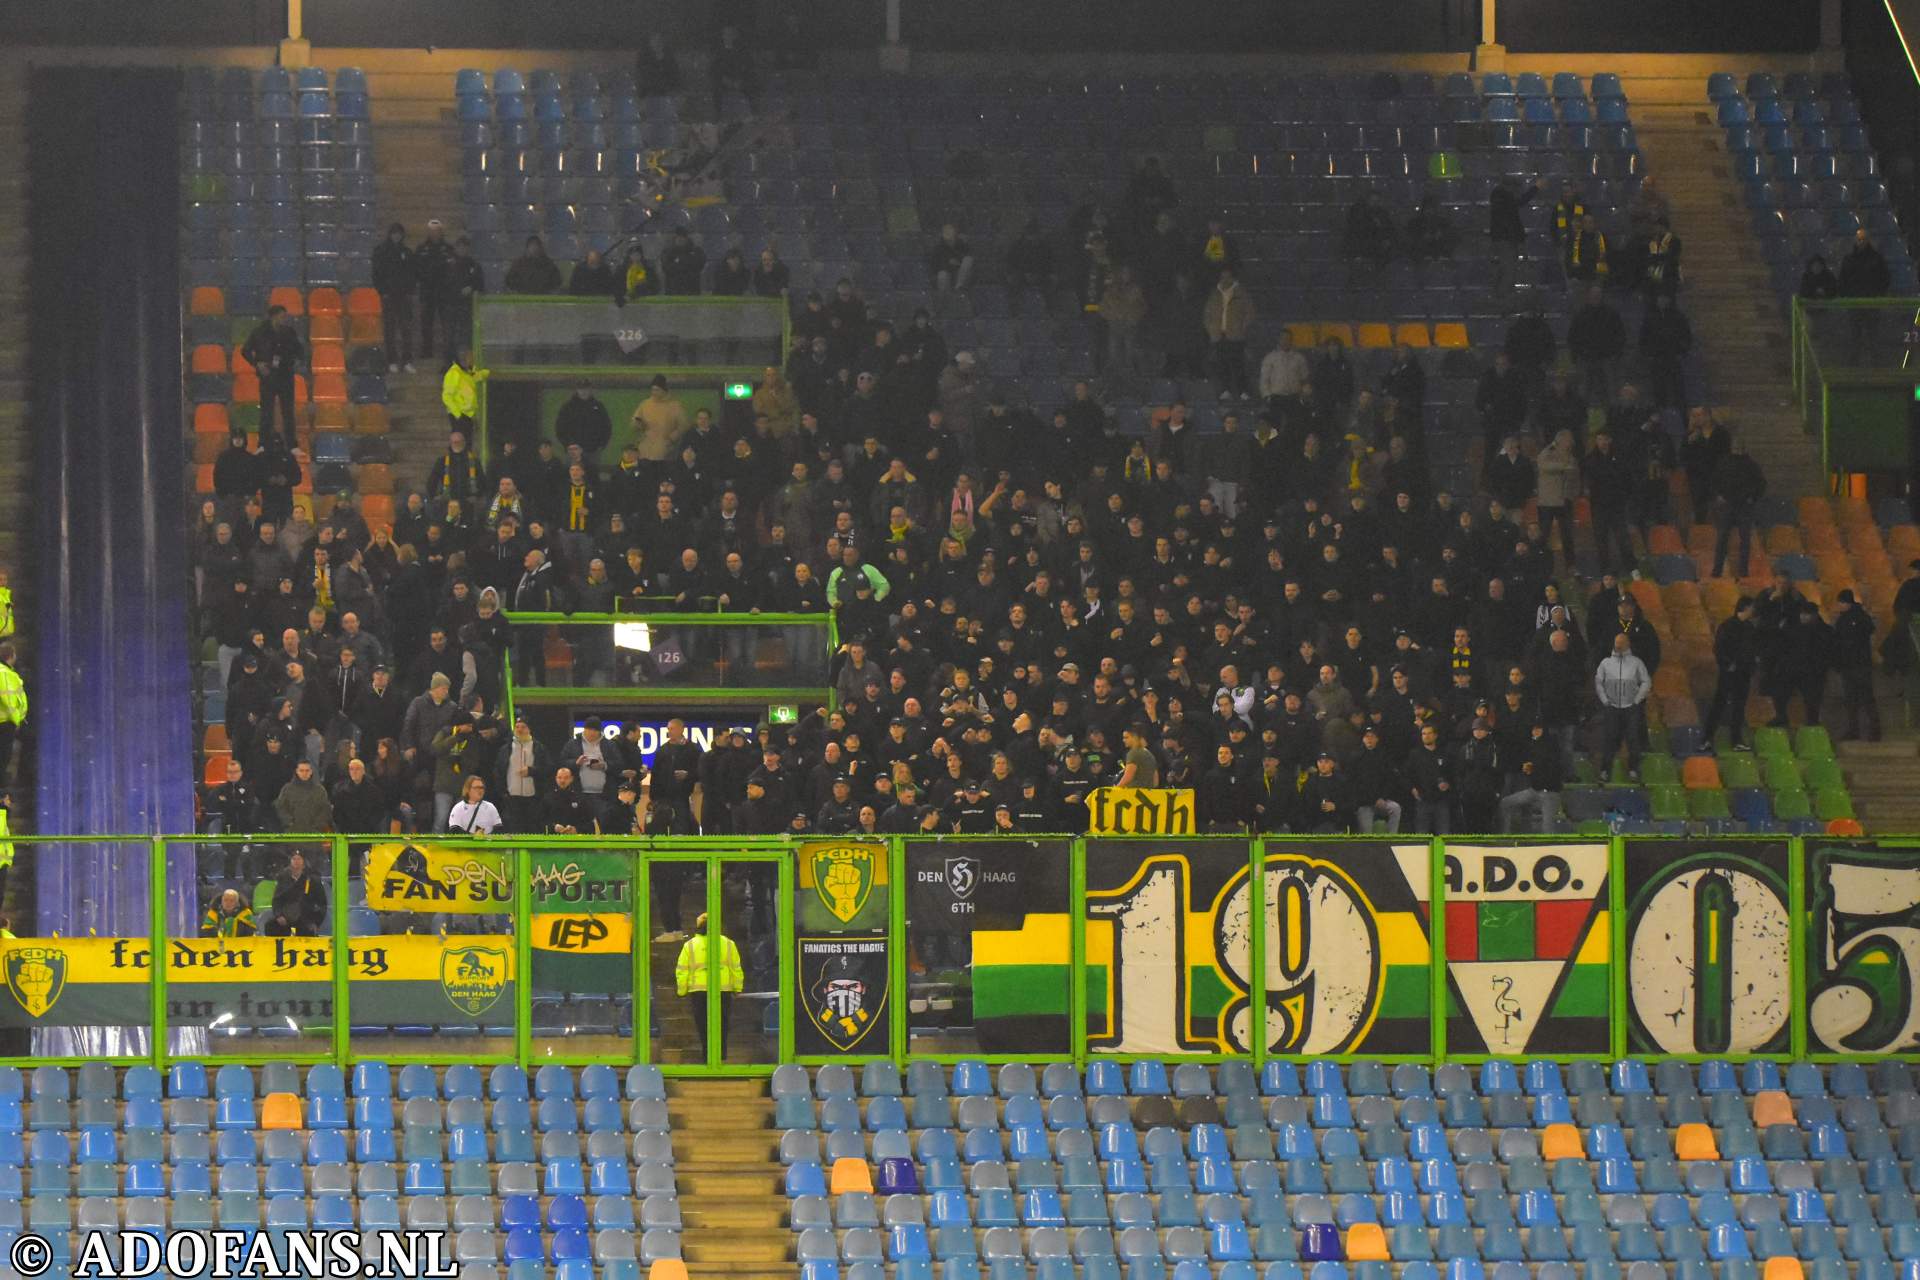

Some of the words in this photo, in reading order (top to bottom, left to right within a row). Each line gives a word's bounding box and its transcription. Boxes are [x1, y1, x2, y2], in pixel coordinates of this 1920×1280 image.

[619, 329, 643, 341] 226
[657, 652, 680, 664] 126
[816, 848, 869, 862] FCDH
[531, 863, 586, 886] AAG
[918, 871, 944, 882] DEN
[983, 872, 1016, 882] HAAG
[1444, 854, 1584, 893] A.D.O.
[381, 878, 457, 901] FAN
[468, 880, 629, 903] SUPORT
[951, 902, 976, 913] 6TH
[549, 918, 608, 949] IEP
[7, 947, 64, 961] FCDH
[110, 939, 151, 968] fc
[171, 940, 254, 968] den
[804, 943, 842, 953] FANATICS
[843, 943, 858, 953] THE
[858, 943, 885, 953] HAGUE
[457, 966, 495, 976] FAN
[827, 989, 862, 1018] FTH
